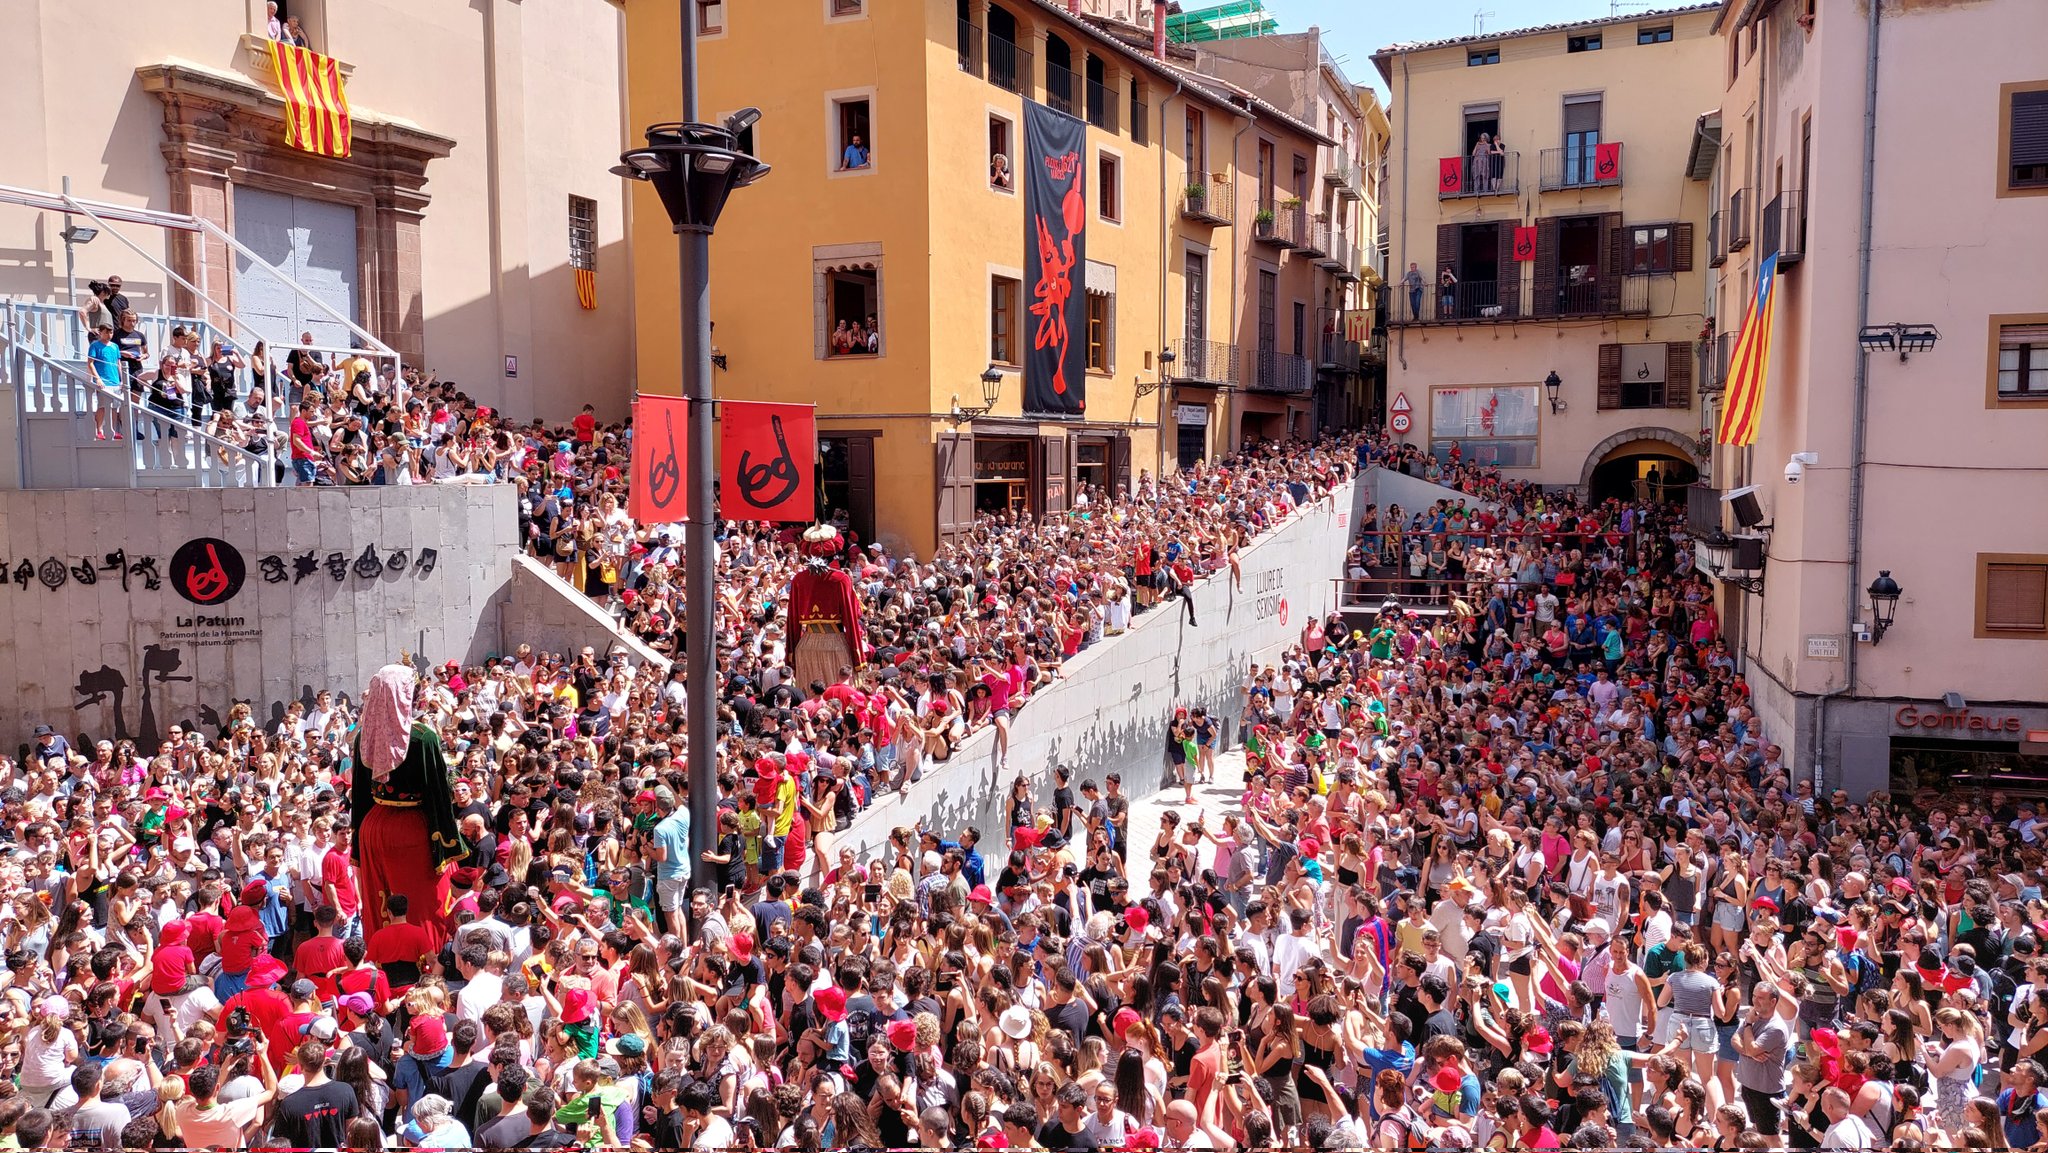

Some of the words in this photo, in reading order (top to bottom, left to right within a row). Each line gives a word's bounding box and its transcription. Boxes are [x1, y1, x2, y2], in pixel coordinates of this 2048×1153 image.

[1395, 419, 1407, 427] 20
[1257, 570, 1275, 594] LLIURE
[1277, 568, 1283, 589] DE
[1257, 594, 1280, 620] SEXISME
[176, 616, 192, 628] La
[197, 615, 245, 627] Patum
[160, 630, 198, 639] Patrimoni
[200, 630, 210, 638] de
[212, 629, 220, 637] la
[221, 629, 263, 637] Humanitat
[187, 639, 235, 648] lapatum.cat
[1896, 706, 2021, 732] Gonfaus
